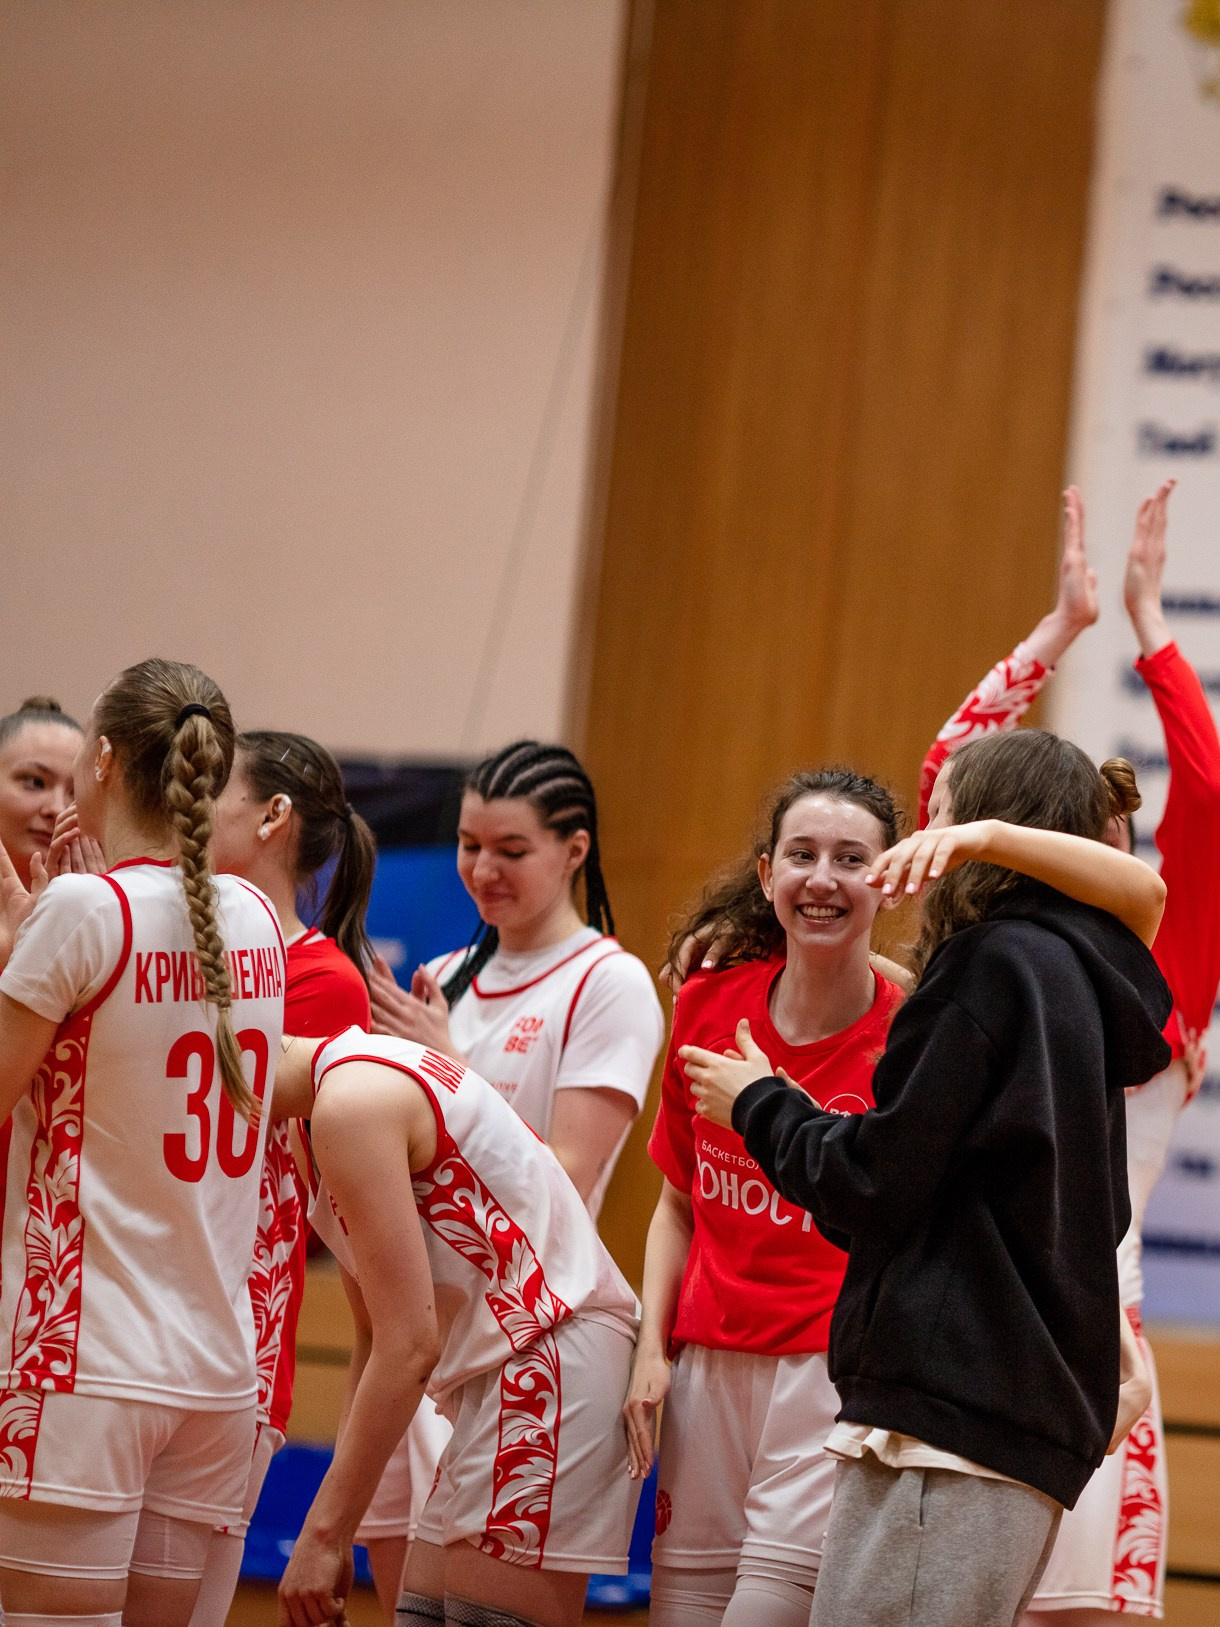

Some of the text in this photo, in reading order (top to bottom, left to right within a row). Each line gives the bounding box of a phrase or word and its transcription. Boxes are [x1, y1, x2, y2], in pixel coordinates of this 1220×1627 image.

[135, 947, 283, 1004] КРИВШЕИНА
[163, 1028, 269, 1183] 30
[701, 1139, 759, 1170] БАСКЕТБО
